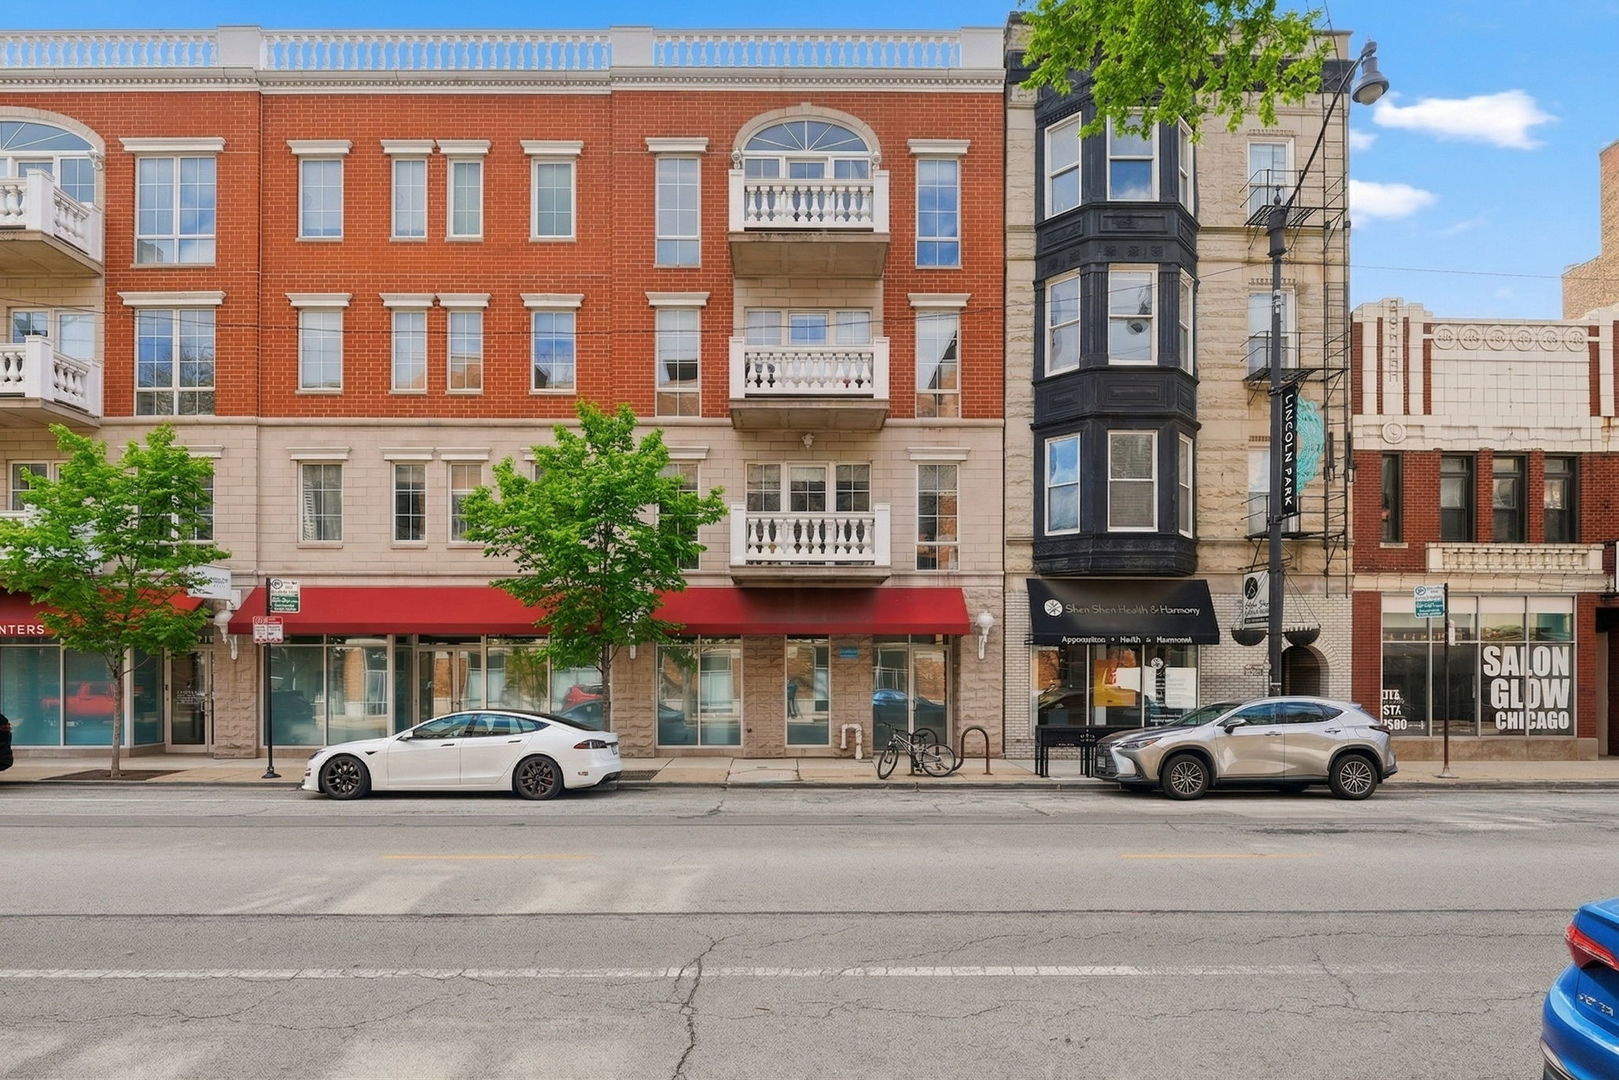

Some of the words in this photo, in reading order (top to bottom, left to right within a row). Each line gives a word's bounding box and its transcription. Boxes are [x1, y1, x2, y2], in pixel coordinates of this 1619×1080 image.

[1284, 393, 1294, 463] LINCOLN
[1284, 467, 1293, 506] PARK
[1065, 604, 1090, 614] Shen
[1091, 604, 1117, 614] Shen
[1118, 605, 1149, 615] Health
[1150, 605, 1159, 614] &
[1160, 605, 1200, 616] Harmony
[0, 624, 45, 635] NTERS
[1483, 646, 1570, 677] SALON
[1490, 678, 1570, 710] GLOW
[1495, 711, 1570, 730] CHICAGO
